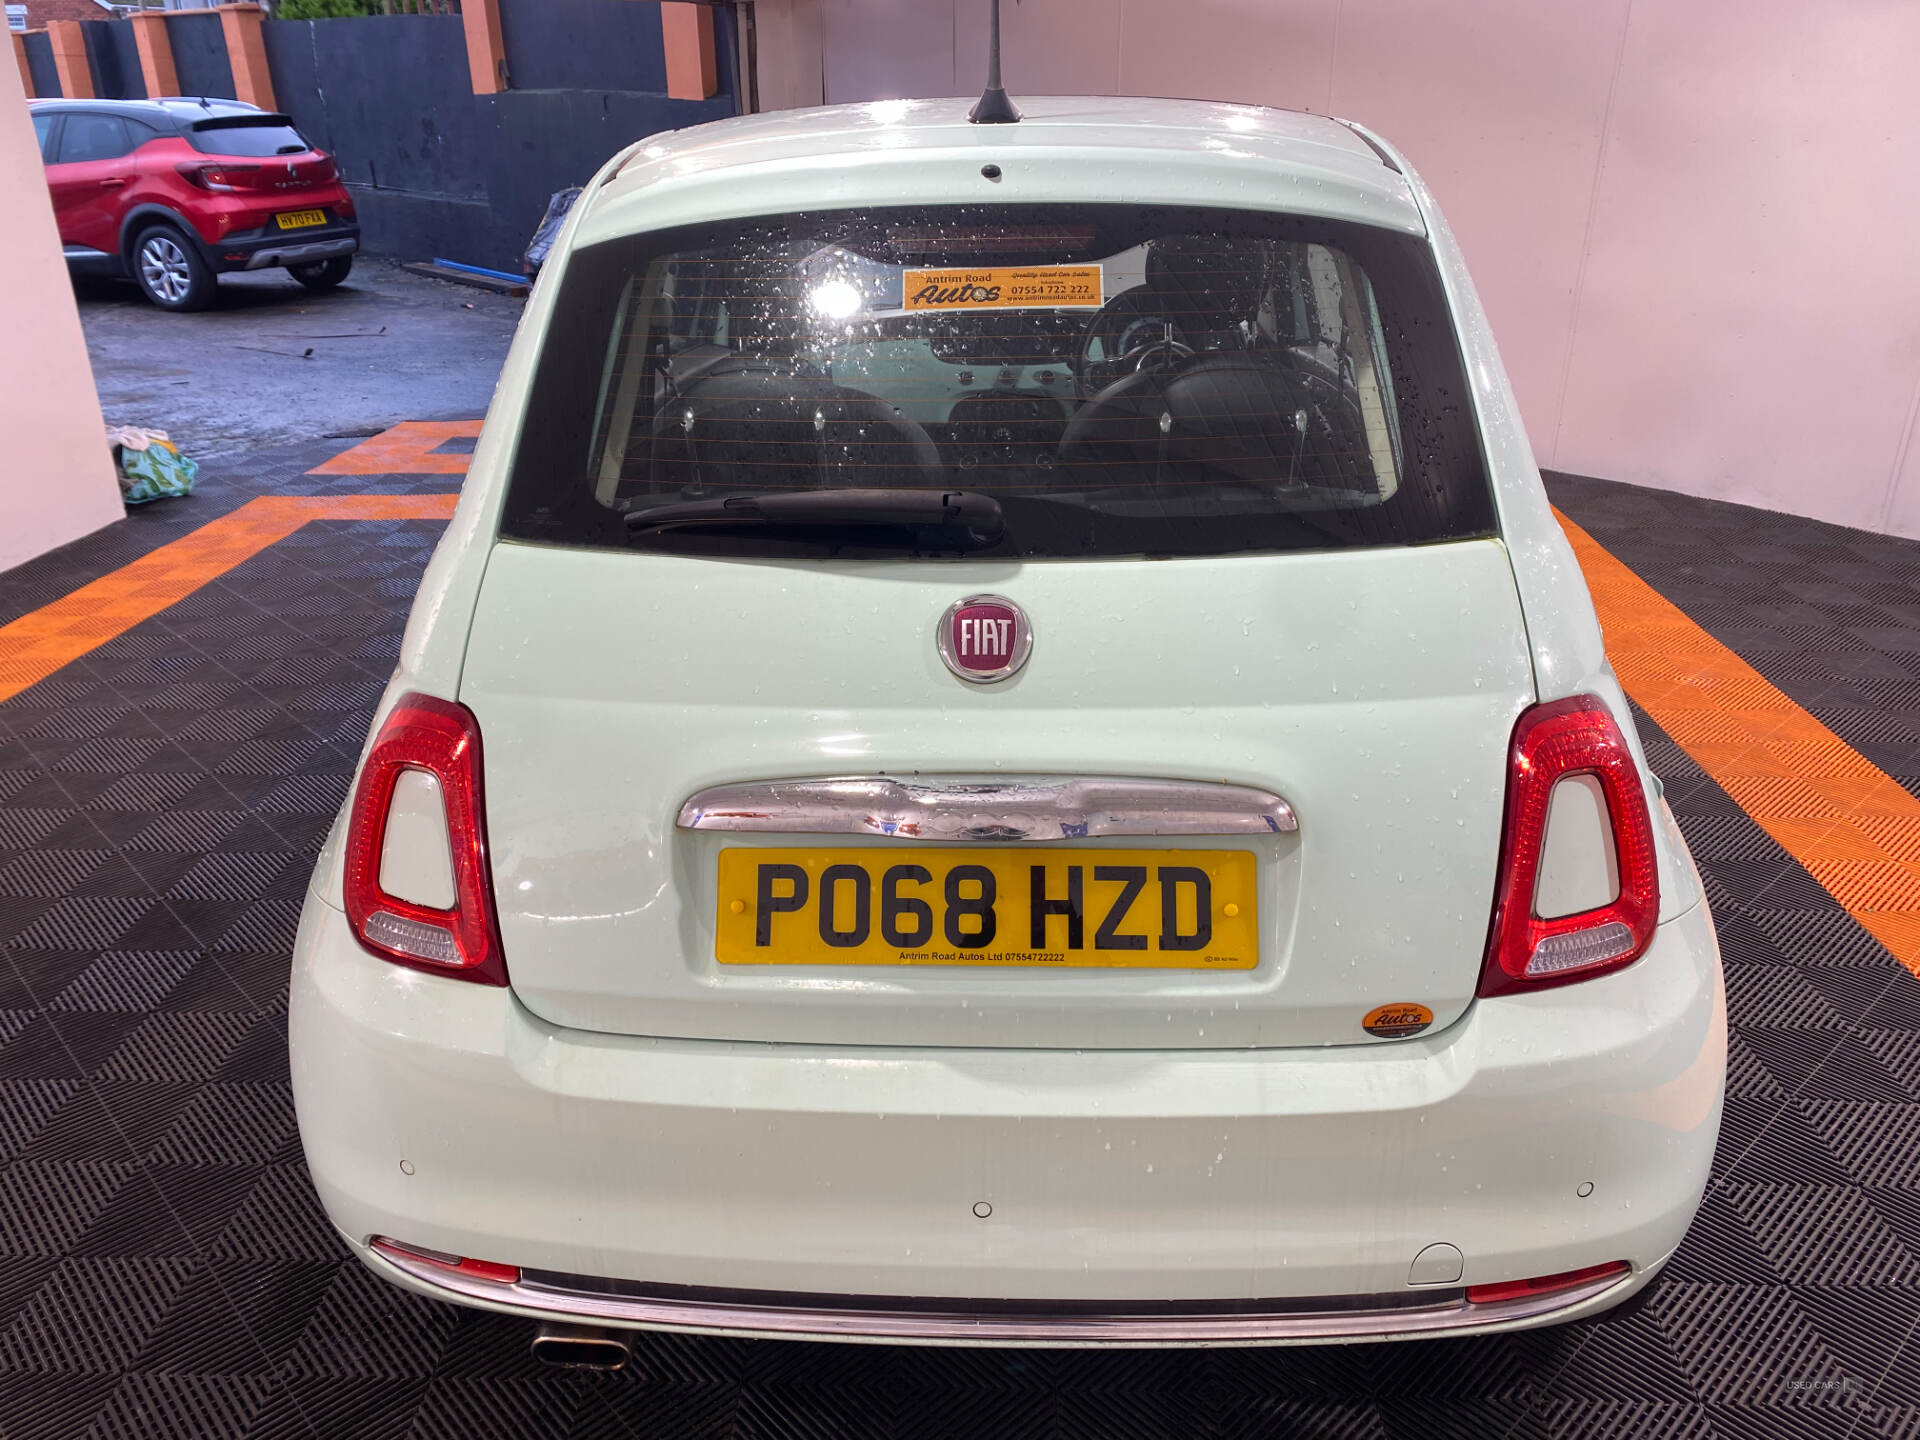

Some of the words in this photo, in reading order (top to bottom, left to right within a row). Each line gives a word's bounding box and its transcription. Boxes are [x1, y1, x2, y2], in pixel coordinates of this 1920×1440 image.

[926, 275, 961, 284] Antrim
[965, 273, 992, 283] Road
[911, 283, 1001, 304] Autos
[1011, 286, 1044, 294] 07554
[1047, 285, 1066, 293] 722
[1070, 285, 1089, 293] 222
[961, 619, 1012, 656] FIAT
[755, 863, 997, 949] PO68
[1029, 865, 1213, 954] HZD
[899, 952, 929, 960] Antrim
[931, 952, 956, 961] Road
[958, 952, 985, 961] Autos
[988, 953, 1002, 961] Ltd
[1005, 953, 1065, 962] 07554722222
[1374, 1012, 1422, 1026] Autos
